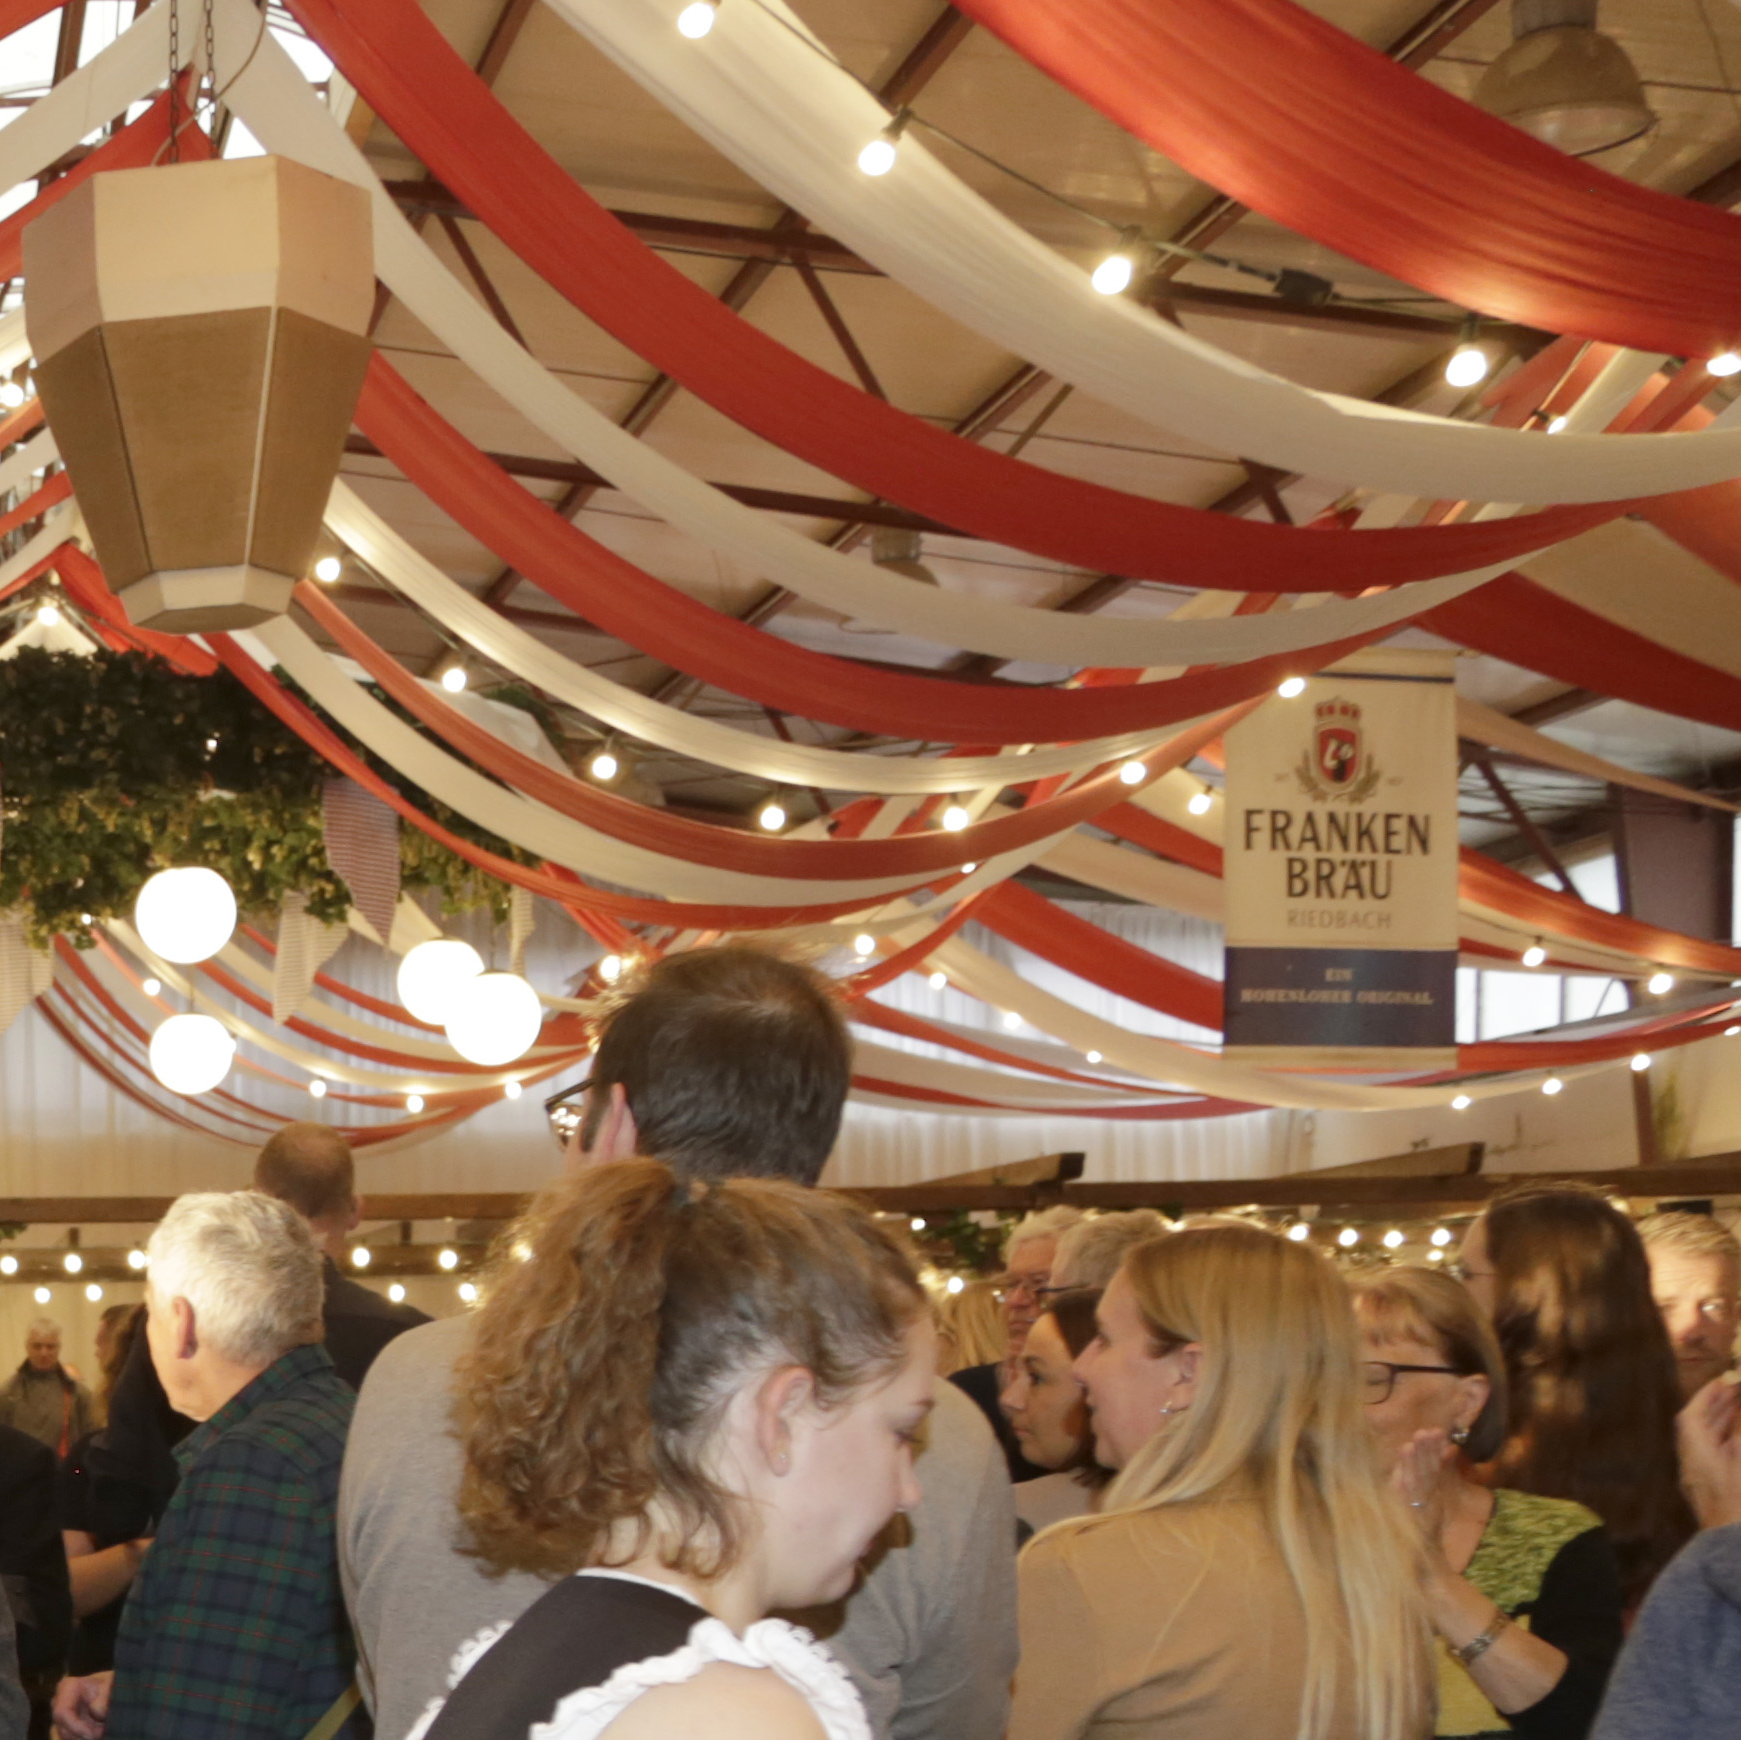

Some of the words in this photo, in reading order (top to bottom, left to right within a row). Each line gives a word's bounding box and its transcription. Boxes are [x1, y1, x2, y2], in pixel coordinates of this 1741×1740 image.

[1243, 808, 1431, 856] FRANKEN
[1286, 856, 1393, 901] BRÄU
[1286, 908, 1393, 930] RIEDBACH
